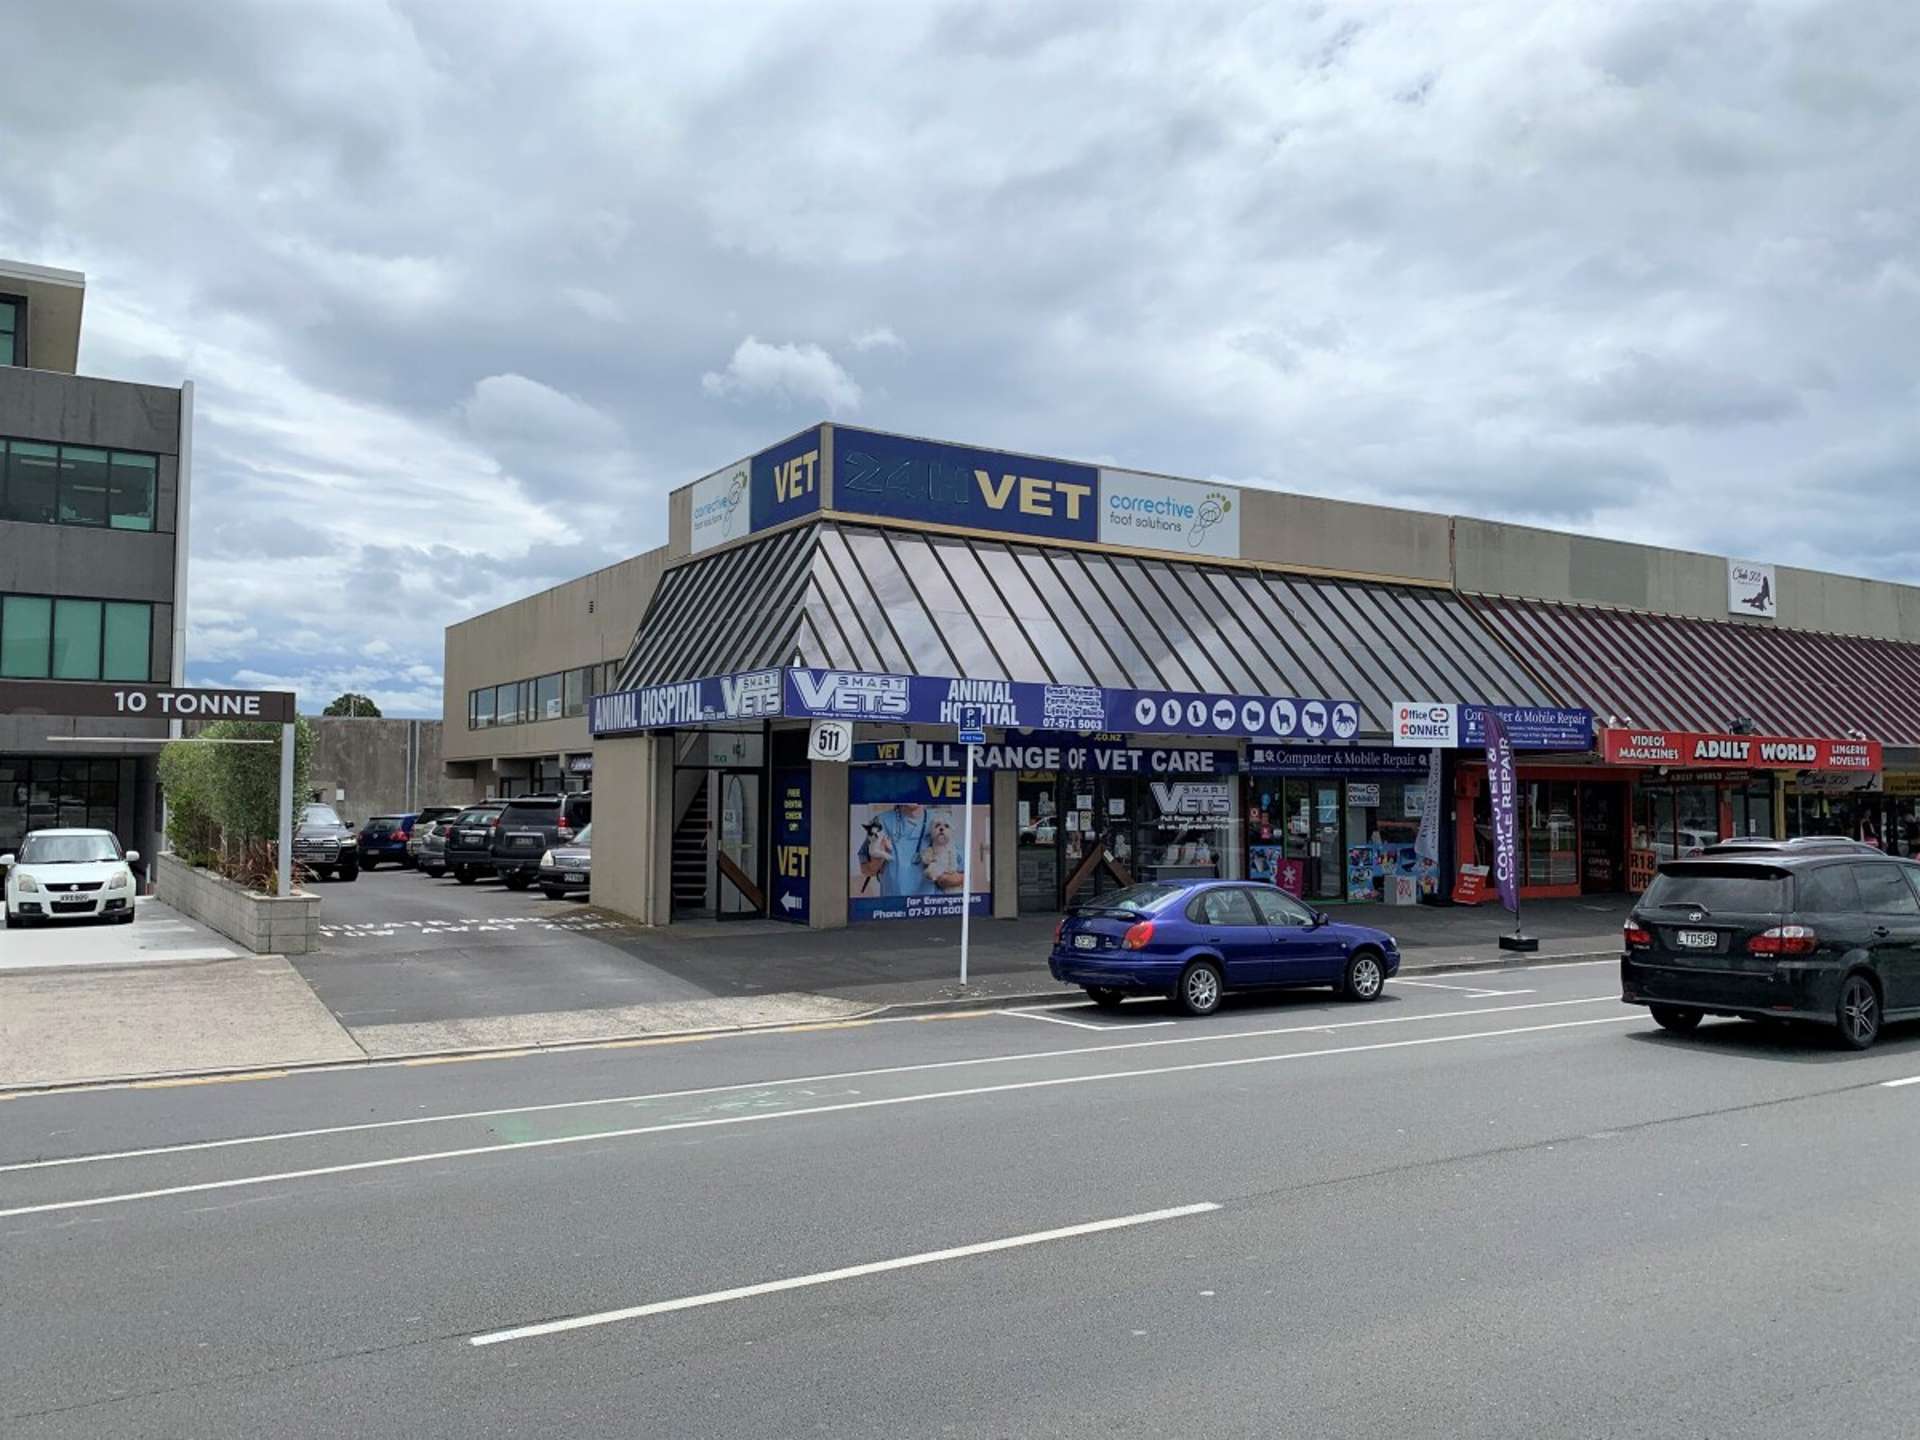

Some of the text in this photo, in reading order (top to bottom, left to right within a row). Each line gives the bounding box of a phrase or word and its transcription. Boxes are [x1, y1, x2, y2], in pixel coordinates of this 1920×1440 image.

[774, 449, 818, 503] VET
[973, 470, 1091, 520] VET
[1110, 494, 1194, 518] corrective
[1110, 511, 1182, 532] foot solutions
[743, 674, 779, 688] SMART
[838, 676, 904, 688] SMART
[790, 669, 909, 714] VETS
[948, 679, 1013, 703] ANIMAL
[114, 691, 260, 715] 10 TONNE
[595, 675, 782, 731] ANIMAL HOSPITAL VETS
[967, 708, 976, 719] P
[1400, 708, 1428, 720] Office
[1512, 712, 1521, 722] &
[1523, 711, 1556, 724] Mobile
[1557, 711, 1586, 726] Repair
[1400, 723, 1449, 736] CONNECT
[819, 730, 840, 751] 511
[1630, 735, 1665, 747] VIDEOS
[972, 745, 1060, 769] RANGE
[1068, 748, 1087, 768] OF
[1094, 749, 1142, 770] VET
[1152, 751, 1214, 772] CARE
[1619, 748, 1679, 760] MAGAZINES
[1694, 740, 1817, 761] ADULT WORLD
[1831, 745, 1867, 755] LINGERIE
[1276, 752, 1416, 768] Computer & Mobile Repair
[1829, 756, 1870, 767] NOVELTIES
[1499, 738, 1512, 808] REPAIR
[1183, 786, 1228, 794] SMART
[778, 846, 810, 877] VET
[1630, 853, 1655, 870] R18
[873, 909, 906, 919] Phone:
